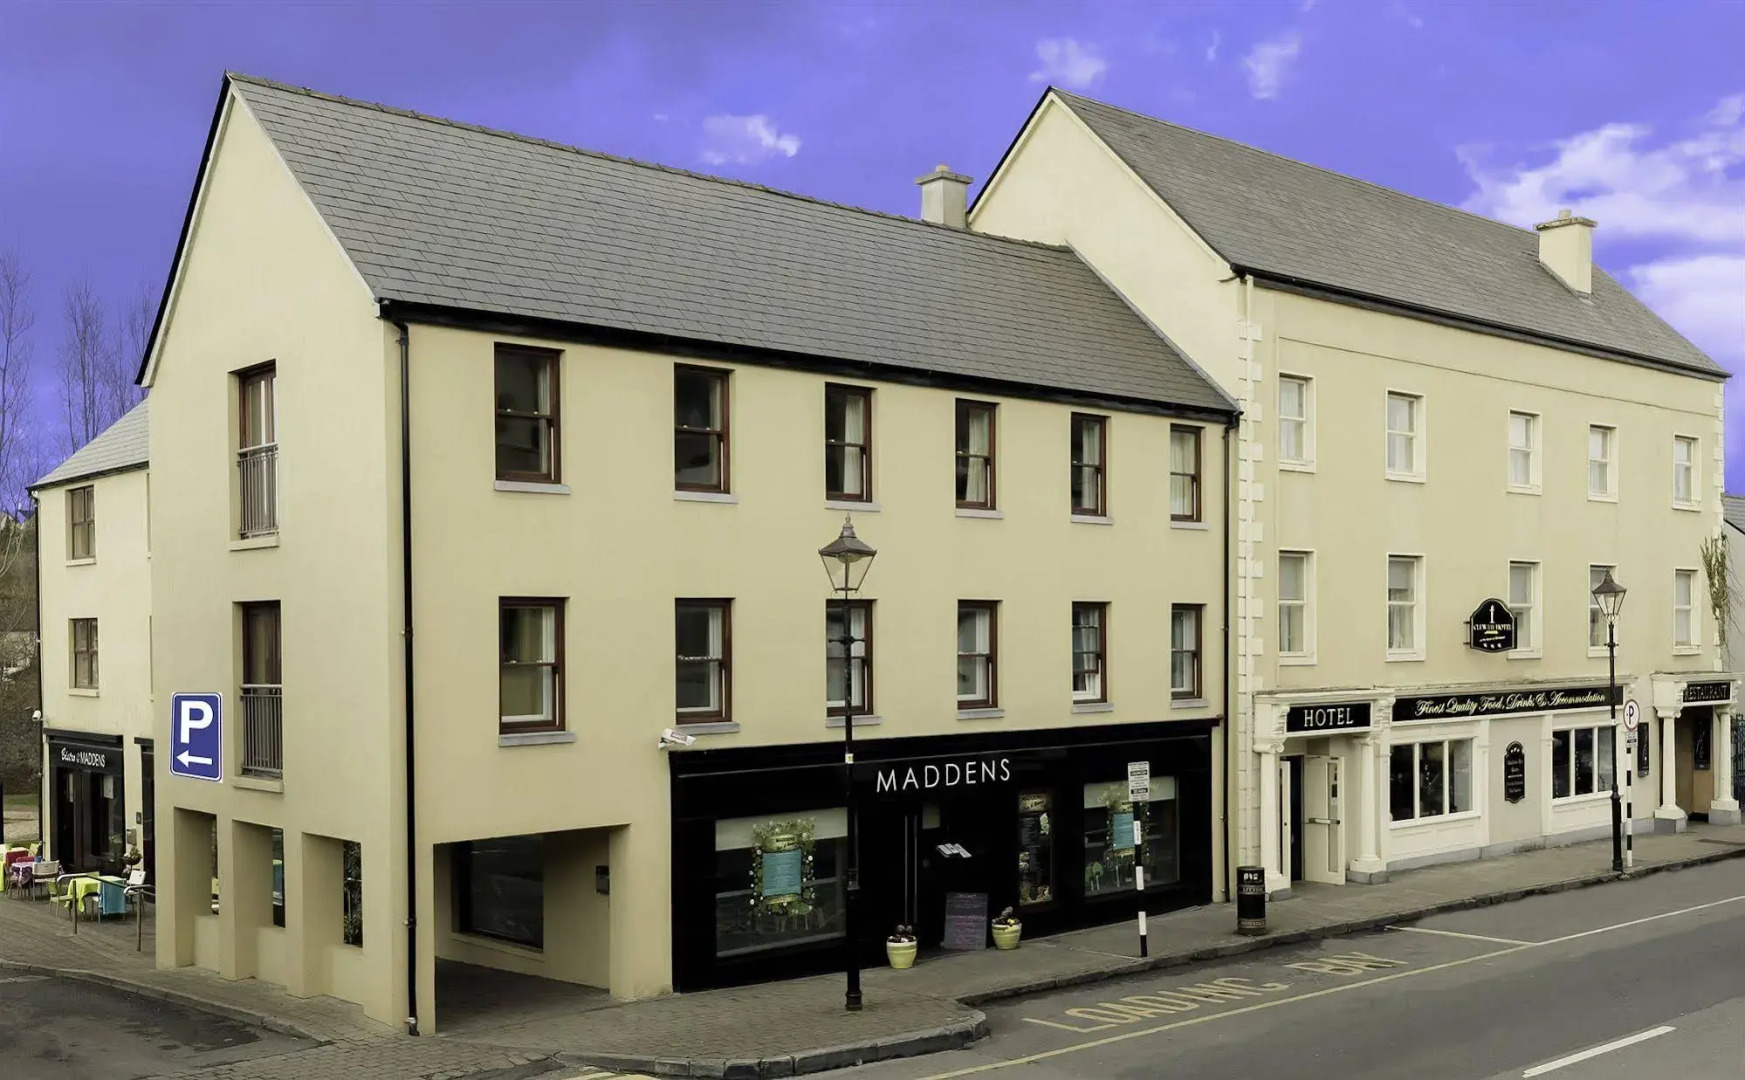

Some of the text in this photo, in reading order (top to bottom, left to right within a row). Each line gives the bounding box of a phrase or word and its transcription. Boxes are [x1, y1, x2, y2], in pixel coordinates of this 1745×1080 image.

[1414, 700, 1445, 717] Finest
[1445, 697, 1478, 715] Quality
[1628, 705, 1635, 725] P
[181, 700, 214, 744] P
[1303, 708, 1354, 727] HOTEL
[80, 751, 106, 768] MADDENS
[876, 758, 1010, 793] MADDENS
